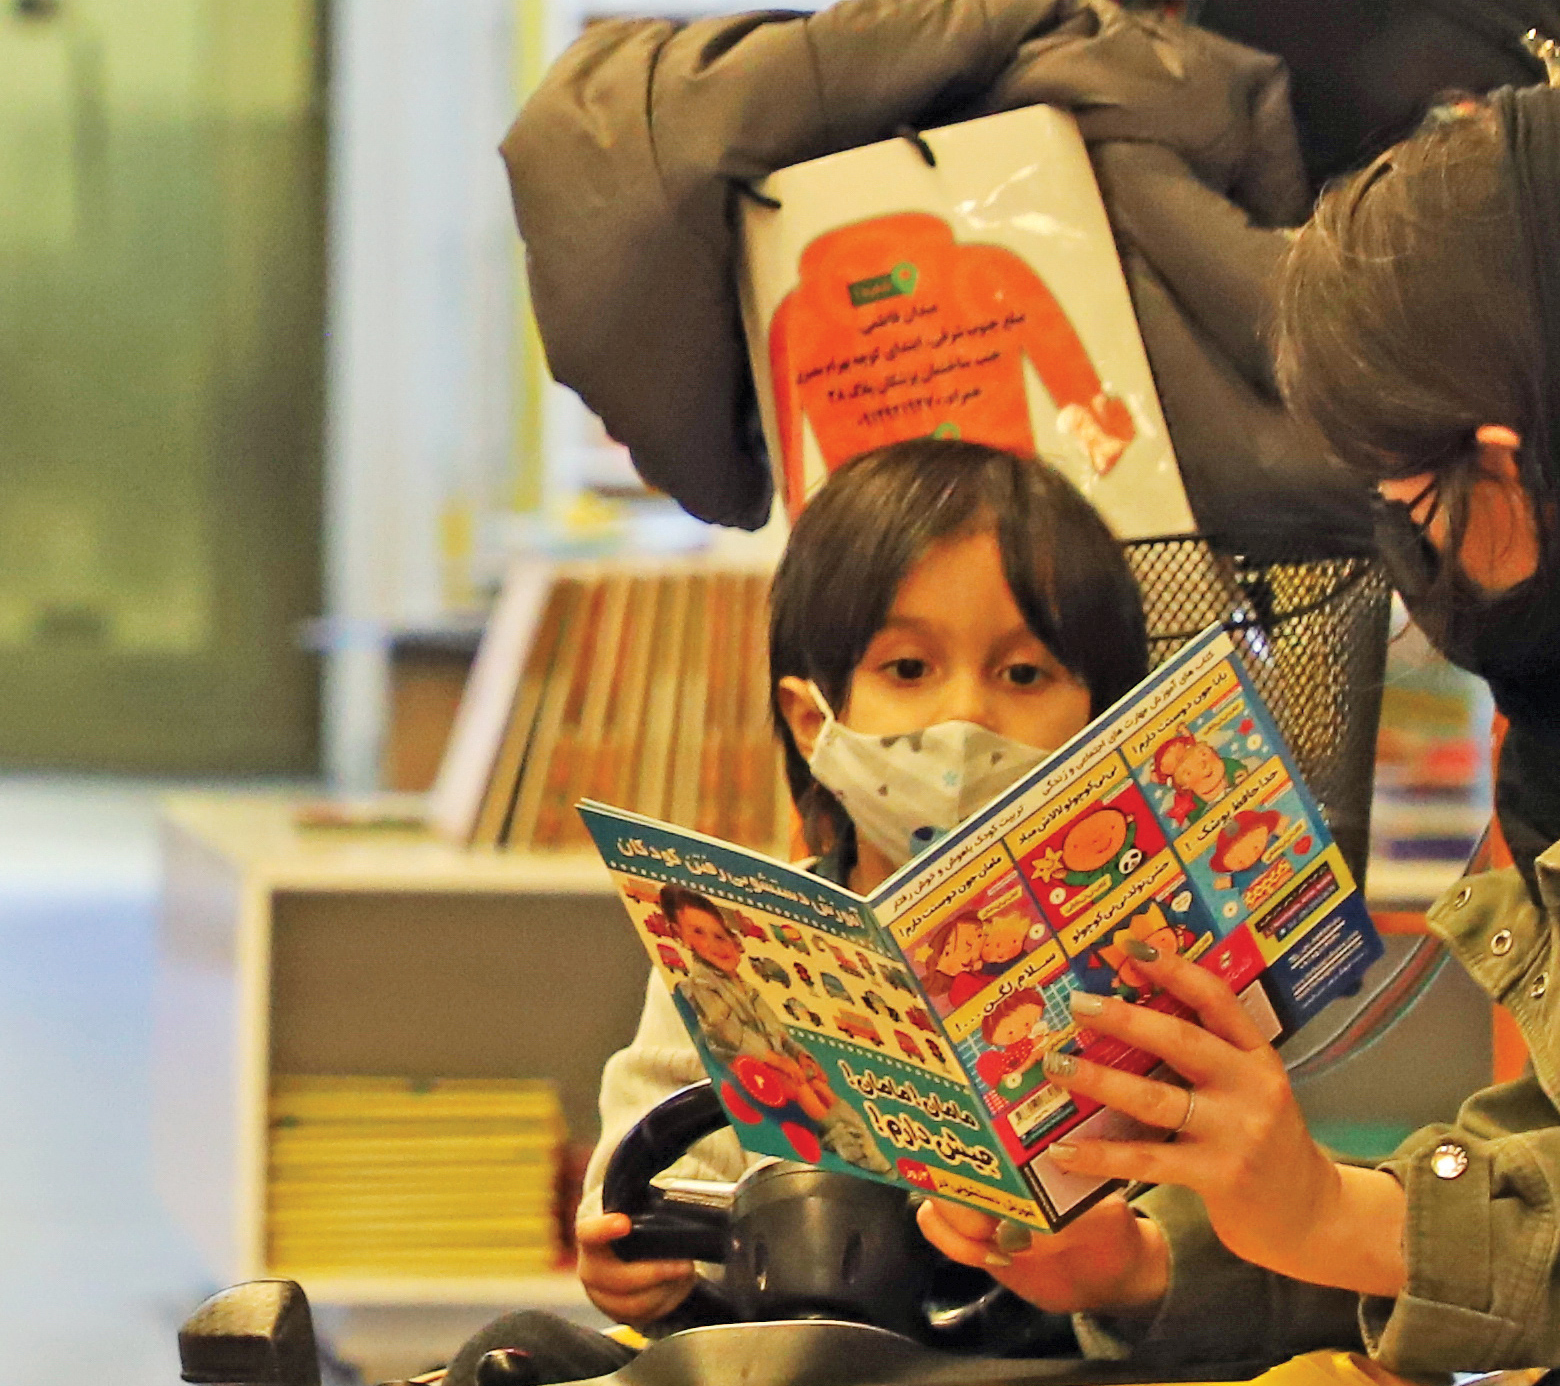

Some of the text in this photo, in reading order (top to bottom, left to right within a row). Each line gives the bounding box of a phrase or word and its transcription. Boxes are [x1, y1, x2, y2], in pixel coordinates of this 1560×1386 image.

[617, 838, 682, 868] کودکان
[684, 854, 728, 884] رفتن
[810, 894, 865, 929] آموزش
[934, 1126, 1002, 1179] جیش
